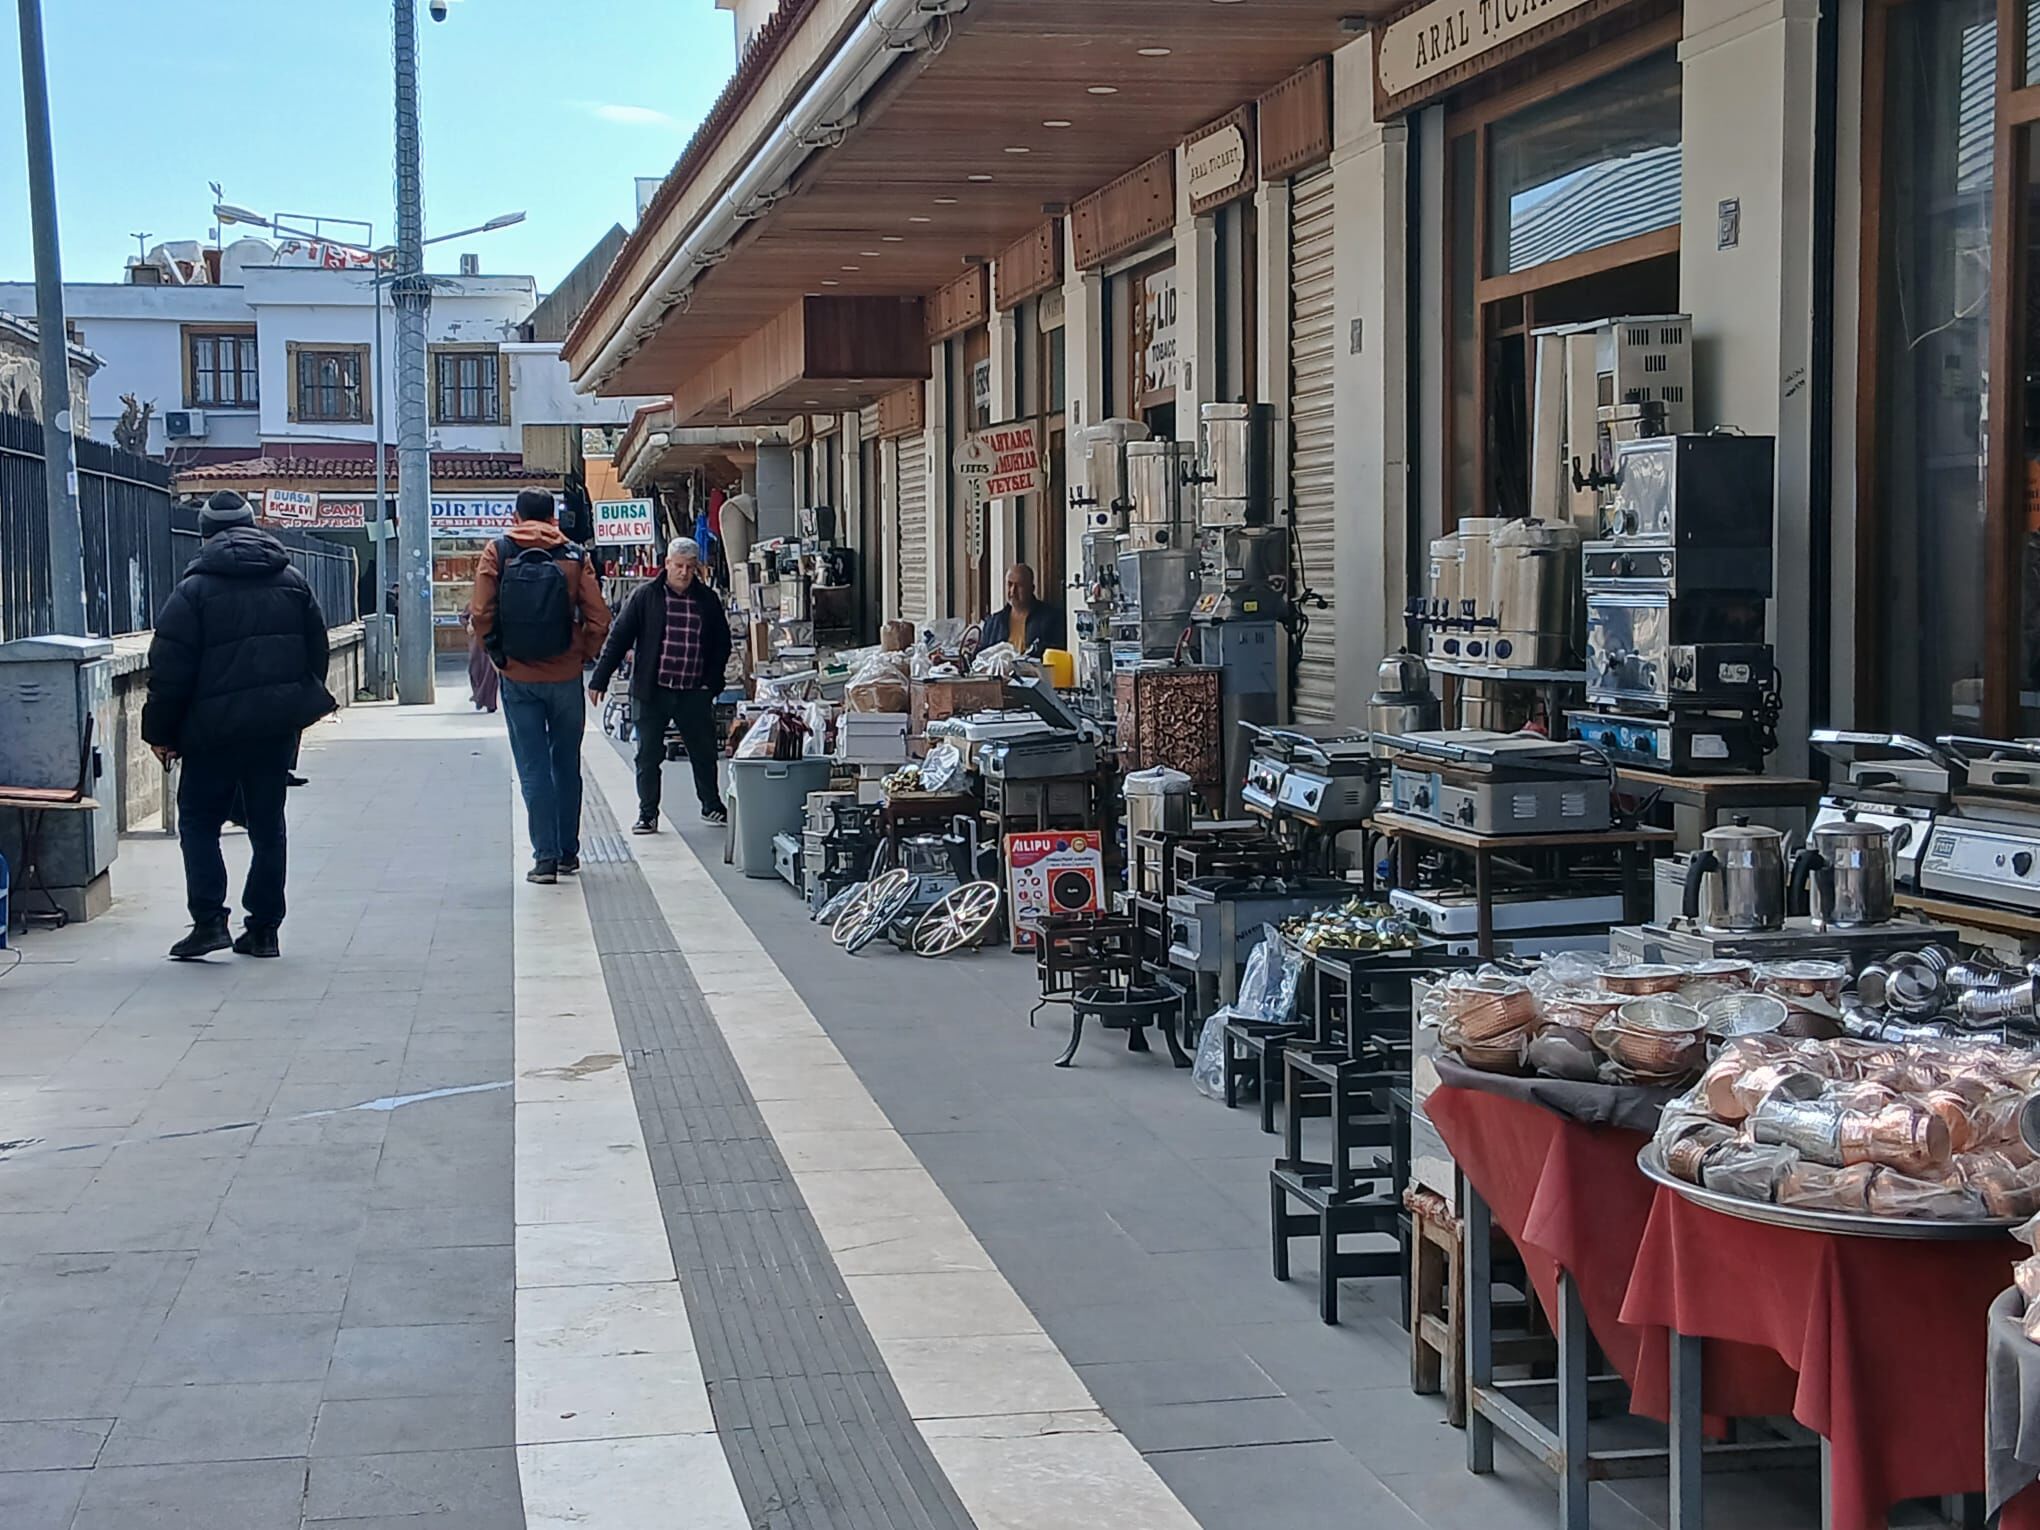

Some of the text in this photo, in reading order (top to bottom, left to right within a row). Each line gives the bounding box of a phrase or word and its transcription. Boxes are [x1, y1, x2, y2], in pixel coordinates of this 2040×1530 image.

[1415, 10, 1470, 69] ARAL
[986, 473, 1035, 495] VEYSEL
[273, 490, 312, 504] BURSA
[601, 504, 647, 519] BURSA
[598, 522, 632, 540] BIÇAK
